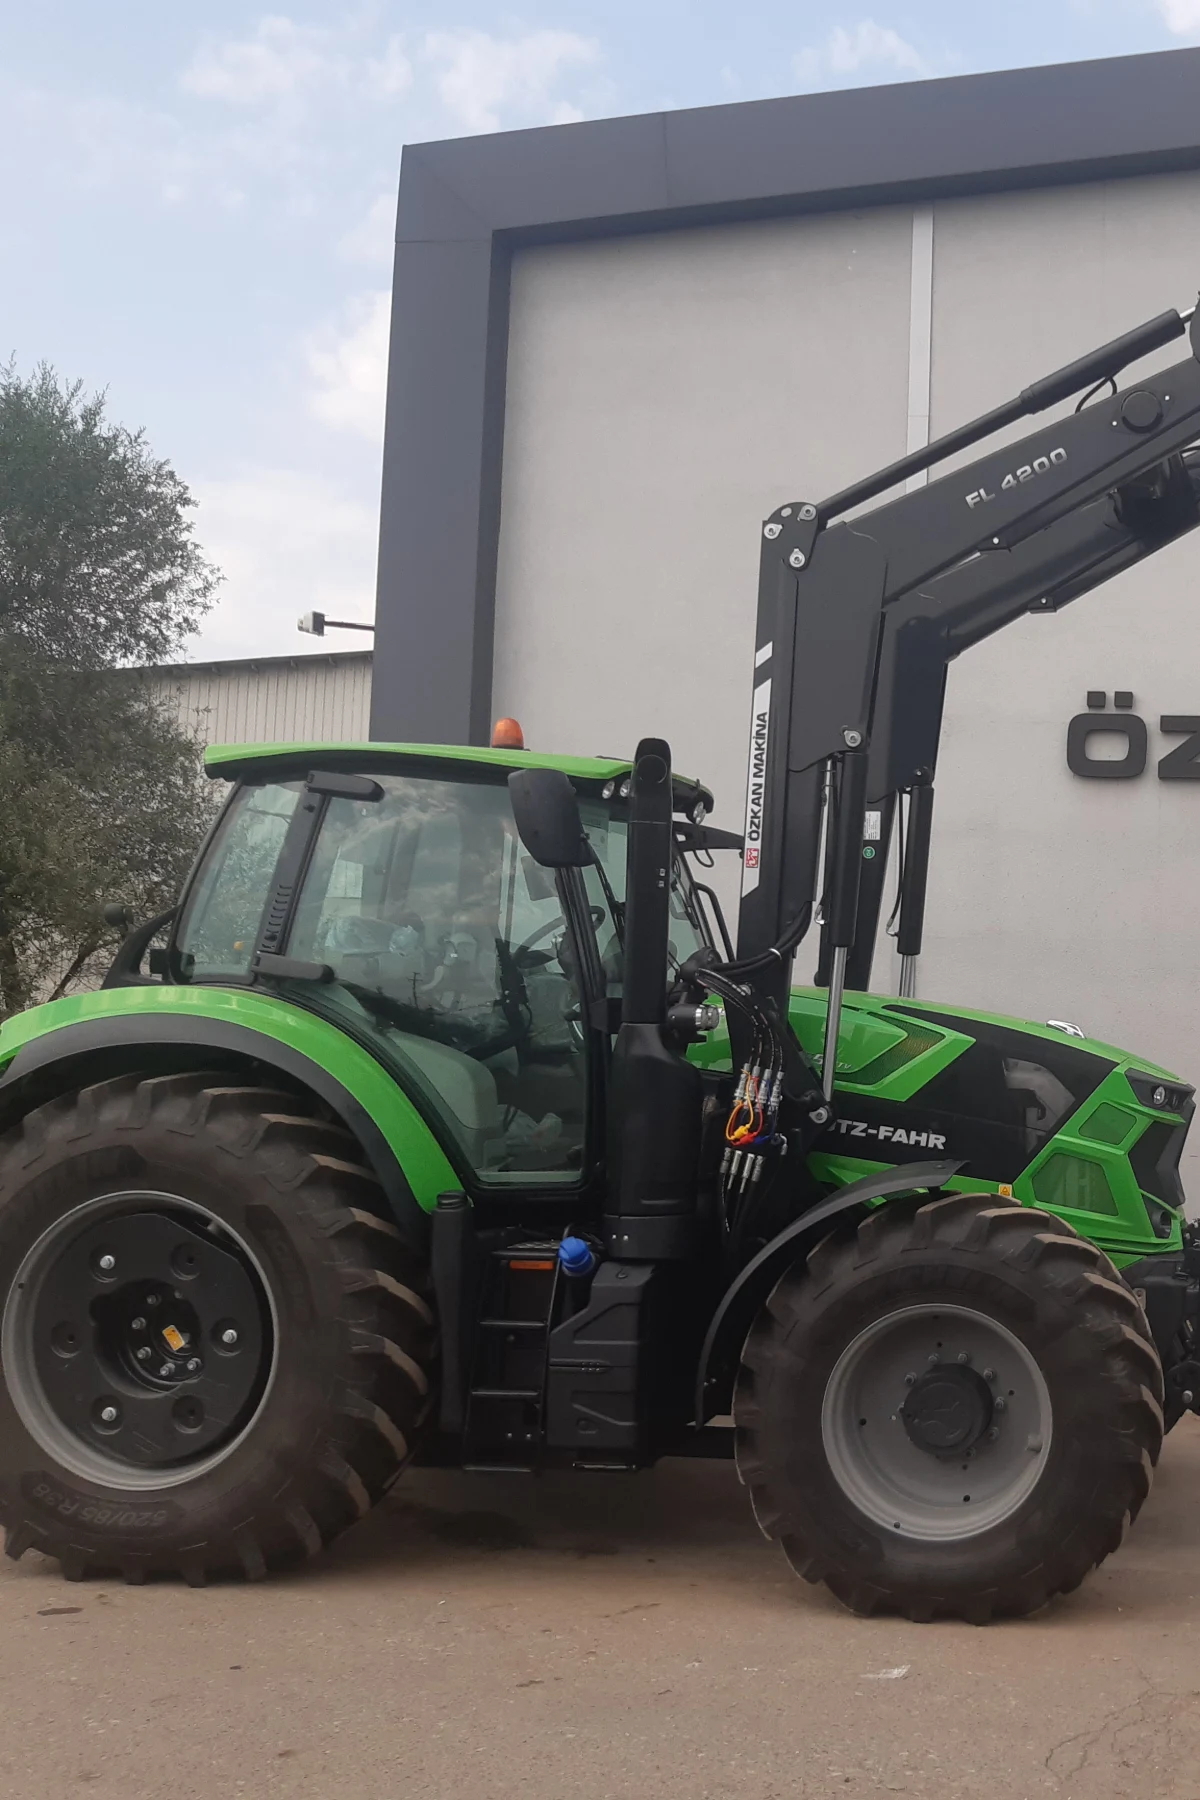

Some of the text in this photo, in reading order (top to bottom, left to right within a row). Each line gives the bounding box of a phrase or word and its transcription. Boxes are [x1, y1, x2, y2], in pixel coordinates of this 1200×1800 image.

[965, 447, 1068, 509] FL 4200
[748, 712, 768, 841] ÖZKAN MAKİNA
[828, 1118, 947, 1150] TZ-FAHR
